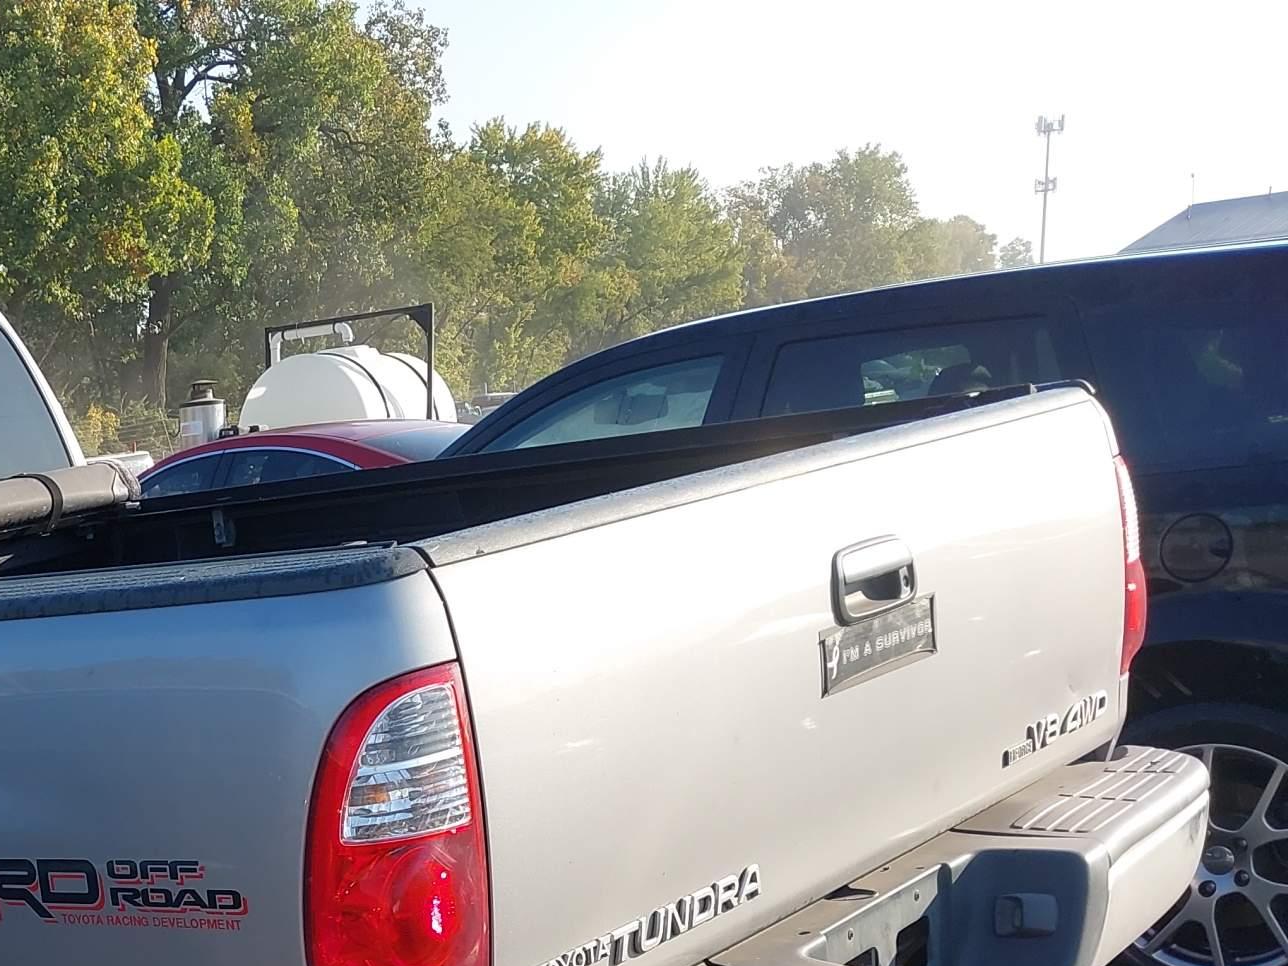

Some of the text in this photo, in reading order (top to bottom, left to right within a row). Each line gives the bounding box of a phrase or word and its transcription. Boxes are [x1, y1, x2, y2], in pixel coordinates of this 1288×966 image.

[863, 641, 873, 656] A
[875, 618, 932, 651] SURVIVOR
[1026, 713, 1060, 752] V8
[107, 860, 205, 885] OFF
[110, 887, 248, 916] ROAD
[62, 913, 241, 931] TOYOTA RACING DEVELOPMENT
